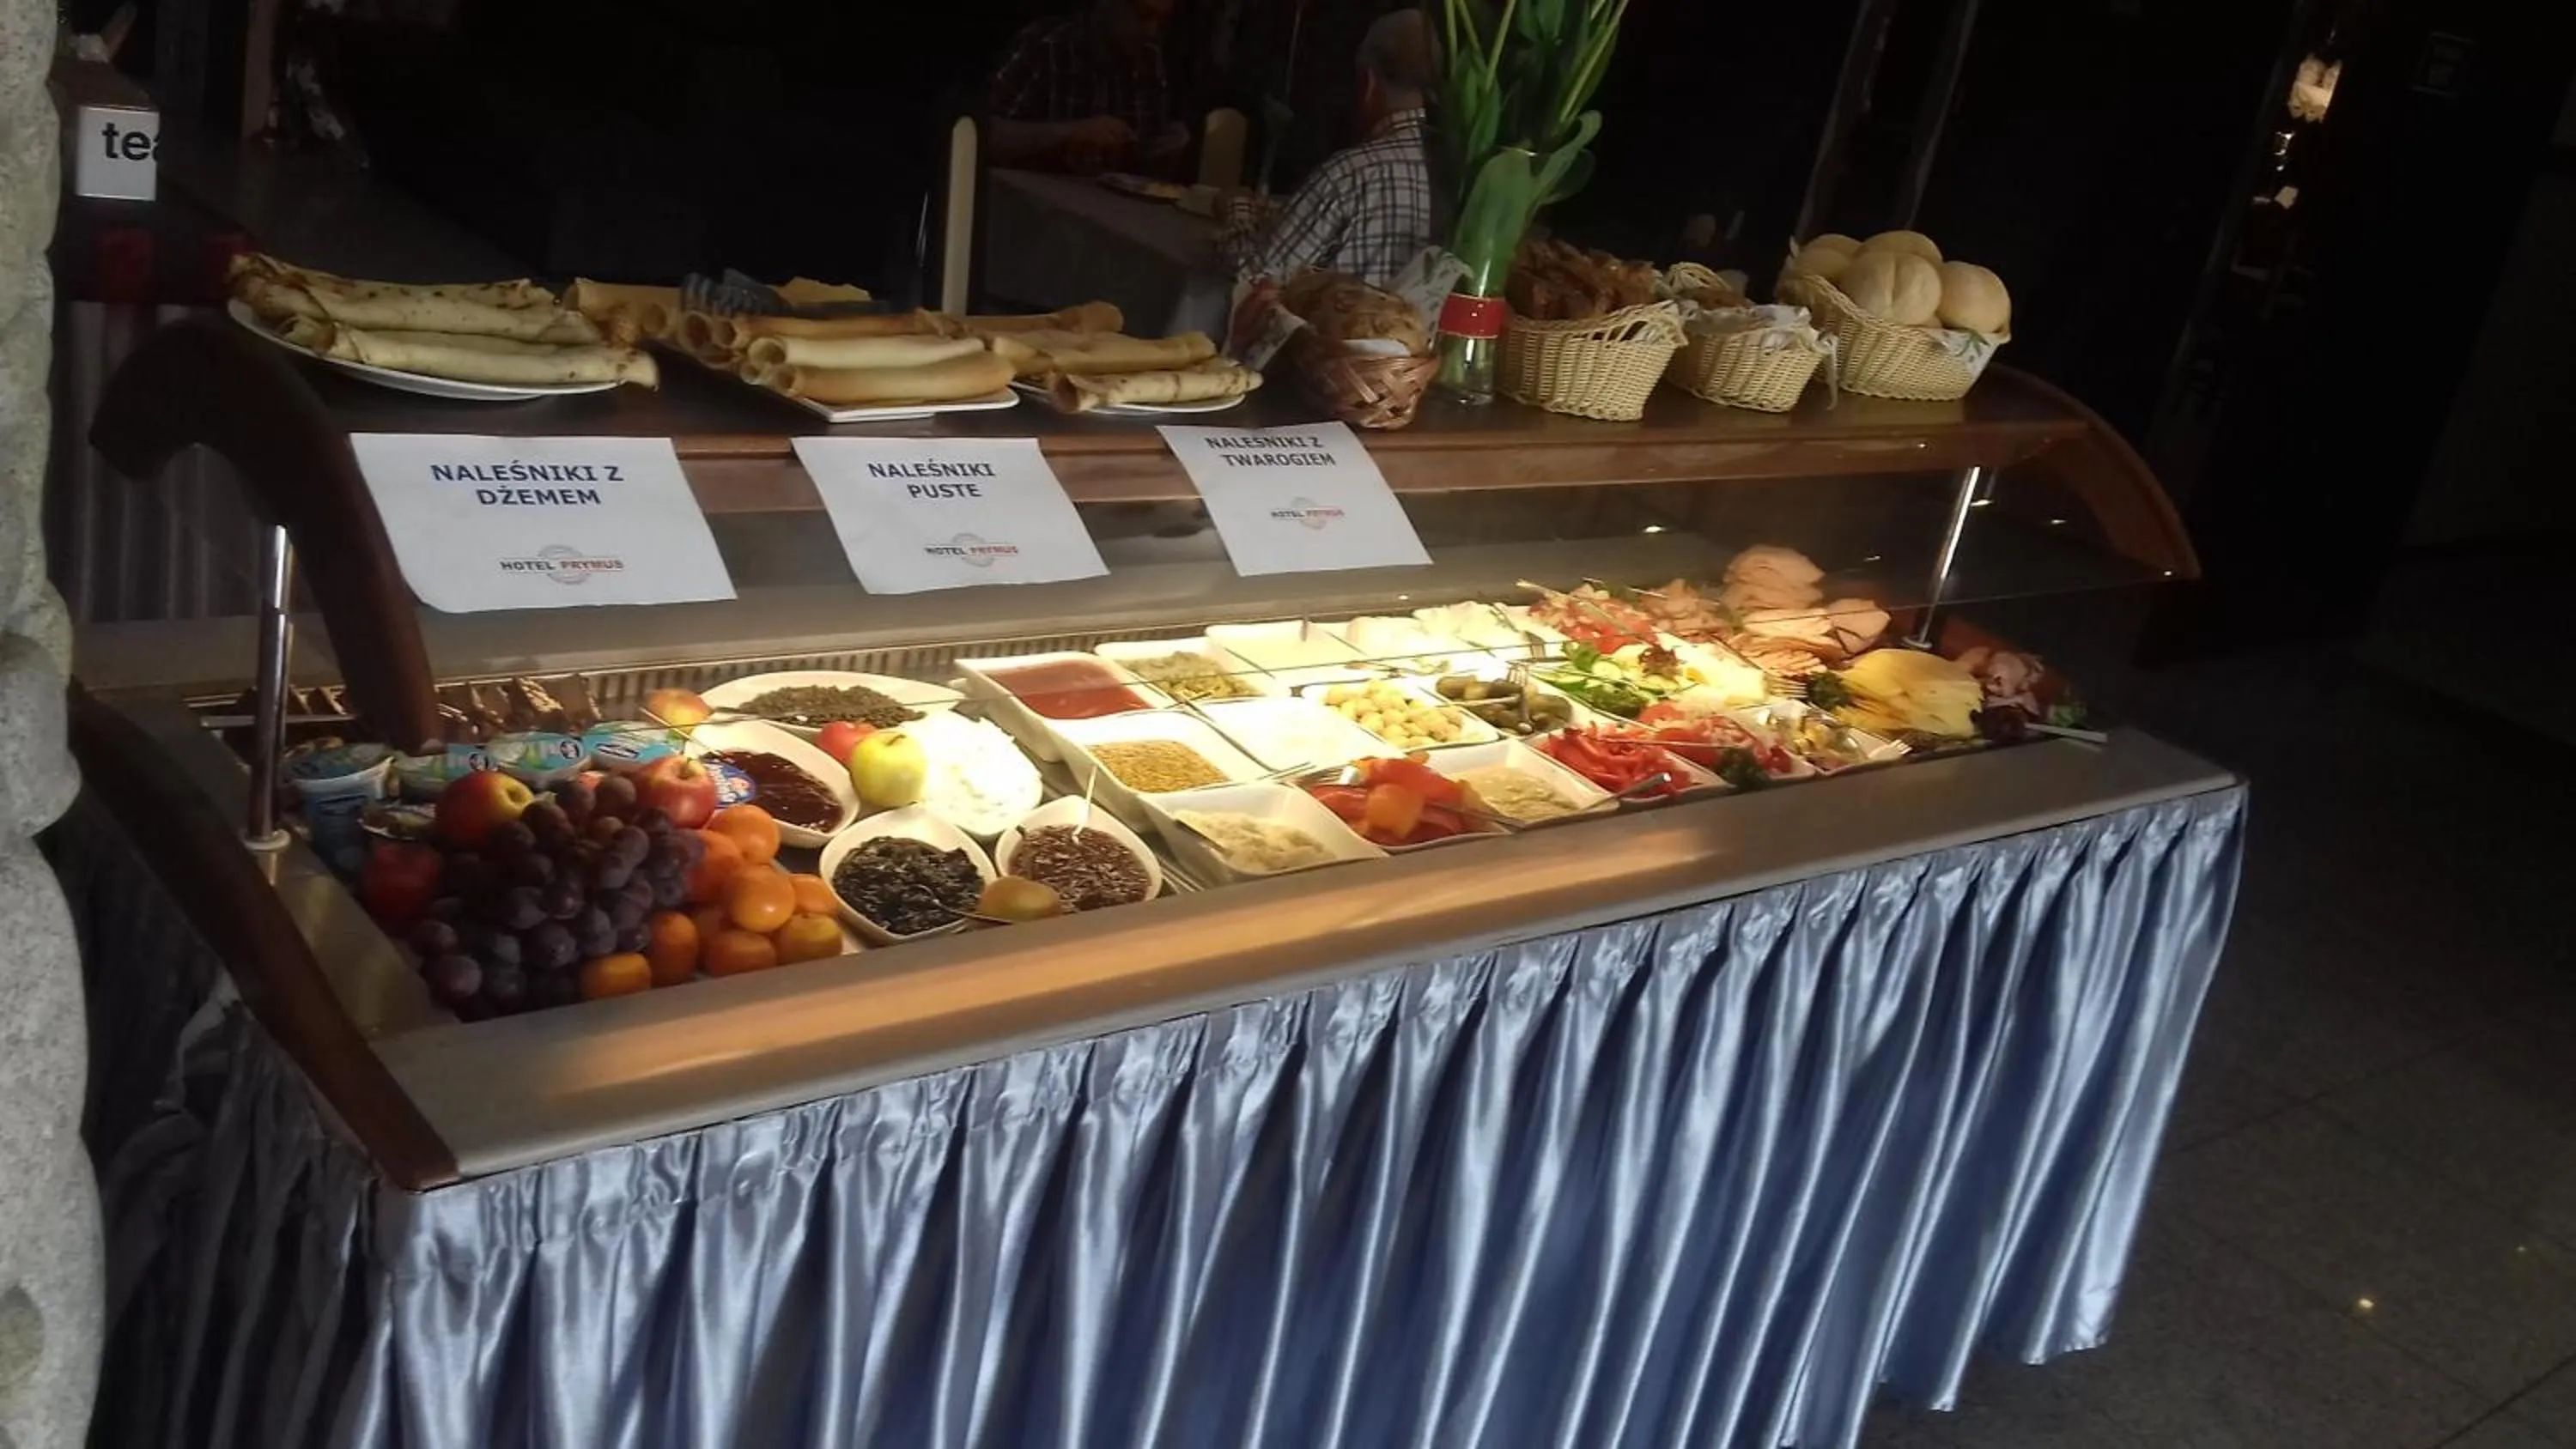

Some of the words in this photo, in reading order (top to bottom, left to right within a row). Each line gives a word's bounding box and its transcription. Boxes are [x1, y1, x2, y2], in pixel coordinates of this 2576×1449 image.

[101, 122, 160, 161] te
[1309, 436, 1324, 448] Z
[867, 458, 996, 477] NALEŚNIKI
[1220, 453, 1336, 467] TWAROGIEM
[431, 460, 598, 482] NALEŚNIKI
[604, 466, 624, 482] Z
[476, 484, 602, 505] DŻEMEM
[908, 482, 982, 499] PUSTE
[500, 561, 555, 571] HOTEL
